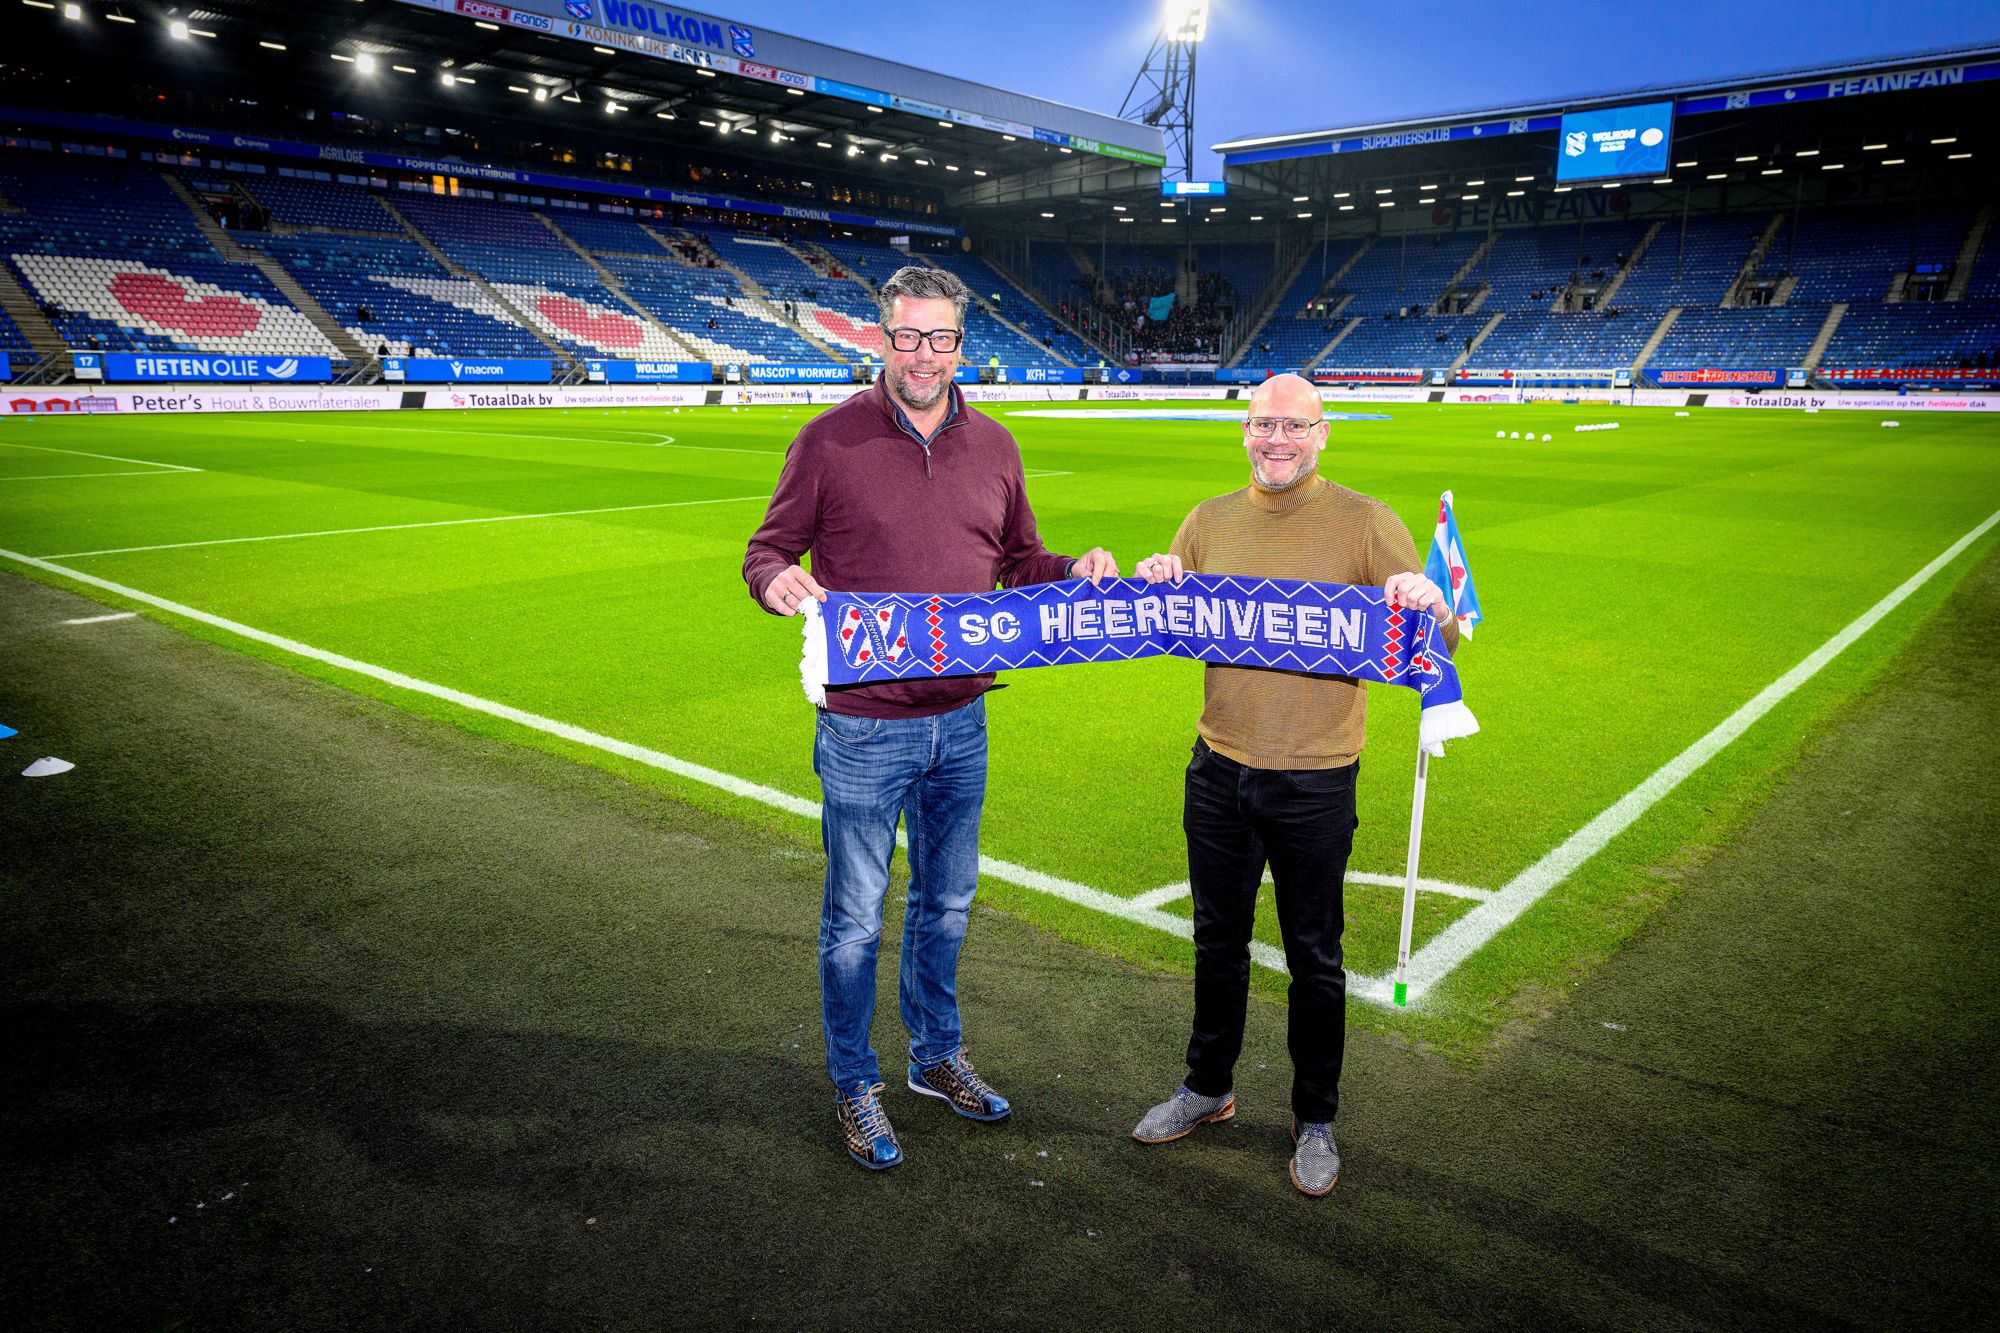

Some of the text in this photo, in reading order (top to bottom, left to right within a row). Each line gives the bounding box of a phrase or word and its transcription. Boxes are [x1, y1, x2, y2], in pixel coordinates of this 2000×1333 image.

[463, 2, 503, 18] FOPPE
[604, 0, 724, 49] WOLKOM
[584, 26, 669, 56] KONINKLIJKE
[1828, 67, 1964, 99] FEANFAN
[1077, 137, 1100, 152] PLUS
[1362, 128, 1450, 150] SUPPORTERSCLUB
[319, 146, 365, 164] AGRILOGE
[405, 159, 516, 180] FOPPE DE HAAN TRIBUNE
[79, 356, 93, 366] 17
[136, 358, 259, 376] FIETEN OLIE
[388, 361, 399, 370] 18
[591, 363, 600, 371] 19
[465, 366, 503, 375] macron
[635, 363, 678, 374] WOLKOM
[728, 365, 738, 373] 20
[798, 367, 849, 378] WORKWEAR
[1830, 368, 2000, 379] IT HEARRENFEAN
[1658, 371, 1697, 383] JACOB
[133, 394, 380, 410] Peter’s Hout & Bouwmaterialen
[469, 393, 535, 406] TotaalDak
[539, 393, 553, 406] bv
[579, 394, 613, 405] specialist
[615, 396, 624, 404] op
[626, 394, 638, 402] het
[640, 394, 671, 402] hellende
[672, 394, 684, 402] dak
[1744, 396, 1807, 407] TotaalDak
[1811, 396, 1825, 407] bv
[1854, 399, 1894, 408] specialist
[1927, 400, 1967, 408] hellende
[1969, 400, 1987, 408] dak
[958, 595, 1367, 653] SC HEERENVEEN
